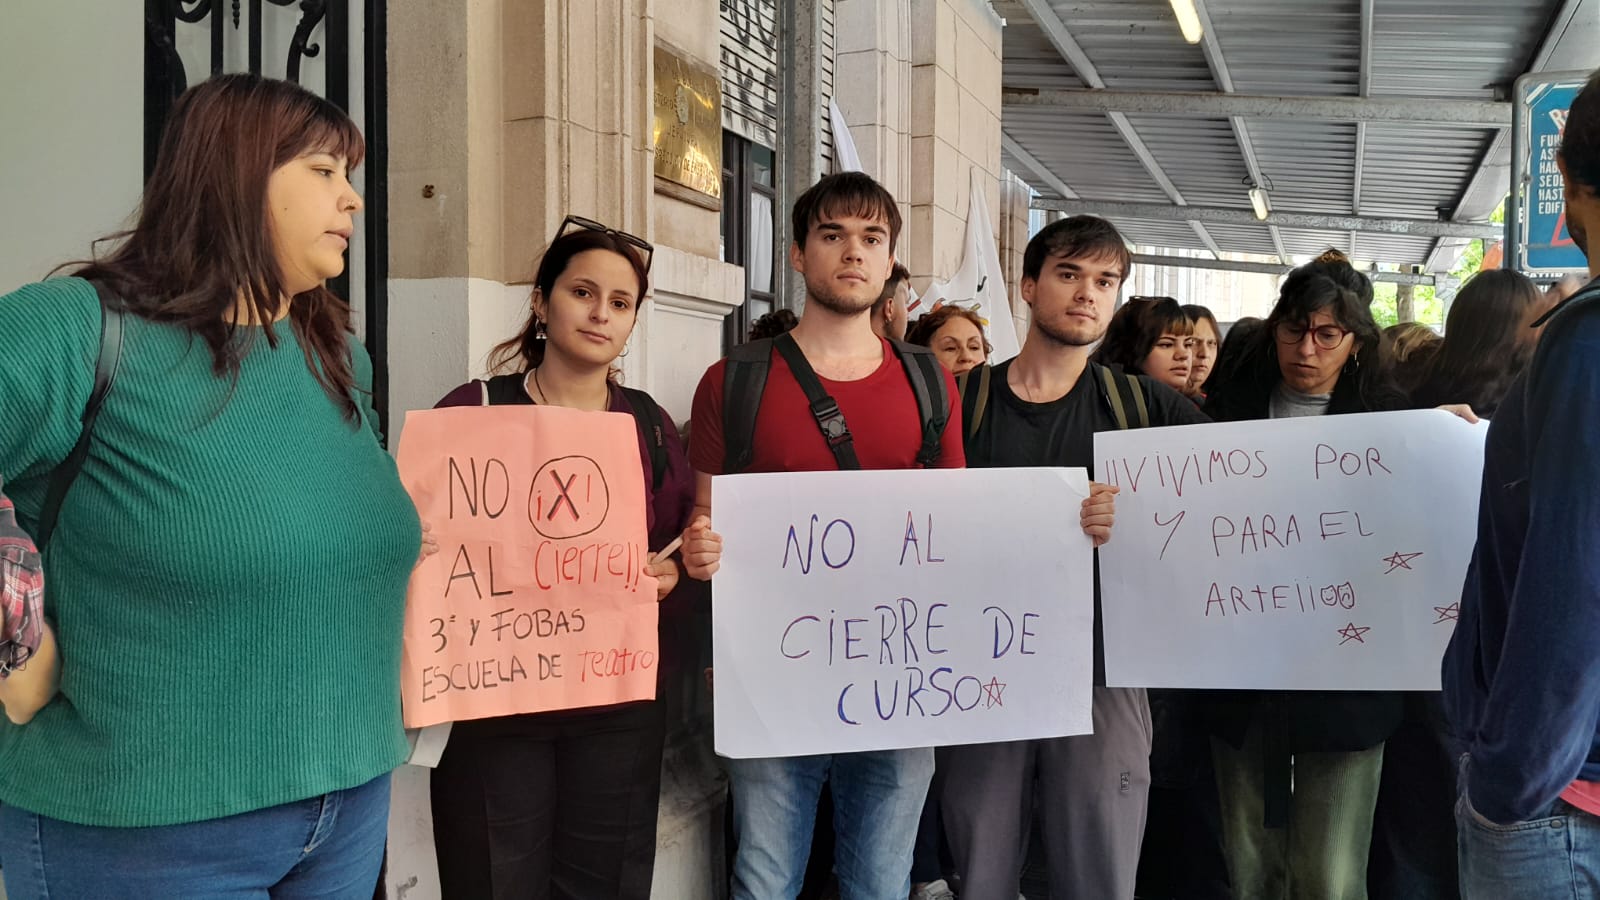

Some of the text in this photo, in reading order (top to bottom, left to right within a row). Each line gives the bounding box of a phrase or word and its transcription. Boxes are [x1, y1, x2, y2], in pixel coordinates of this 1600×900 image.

[1538, 187, 1565, 201] HAST
[1314, 443, 1392, 480] POR
[449, 456, 510, 520] NO
[782, 510, 945, 575] NO AL
[1153, 509, 1375, 561] Y PARA EL
[444, 543, 513, 600] AL
[490, 607, 586, 642] FOBAS
[982, 605, 1041, 660] DE
[422, 655, 527, 703] ESCUELA
[537, 652, 563, 681] DE
